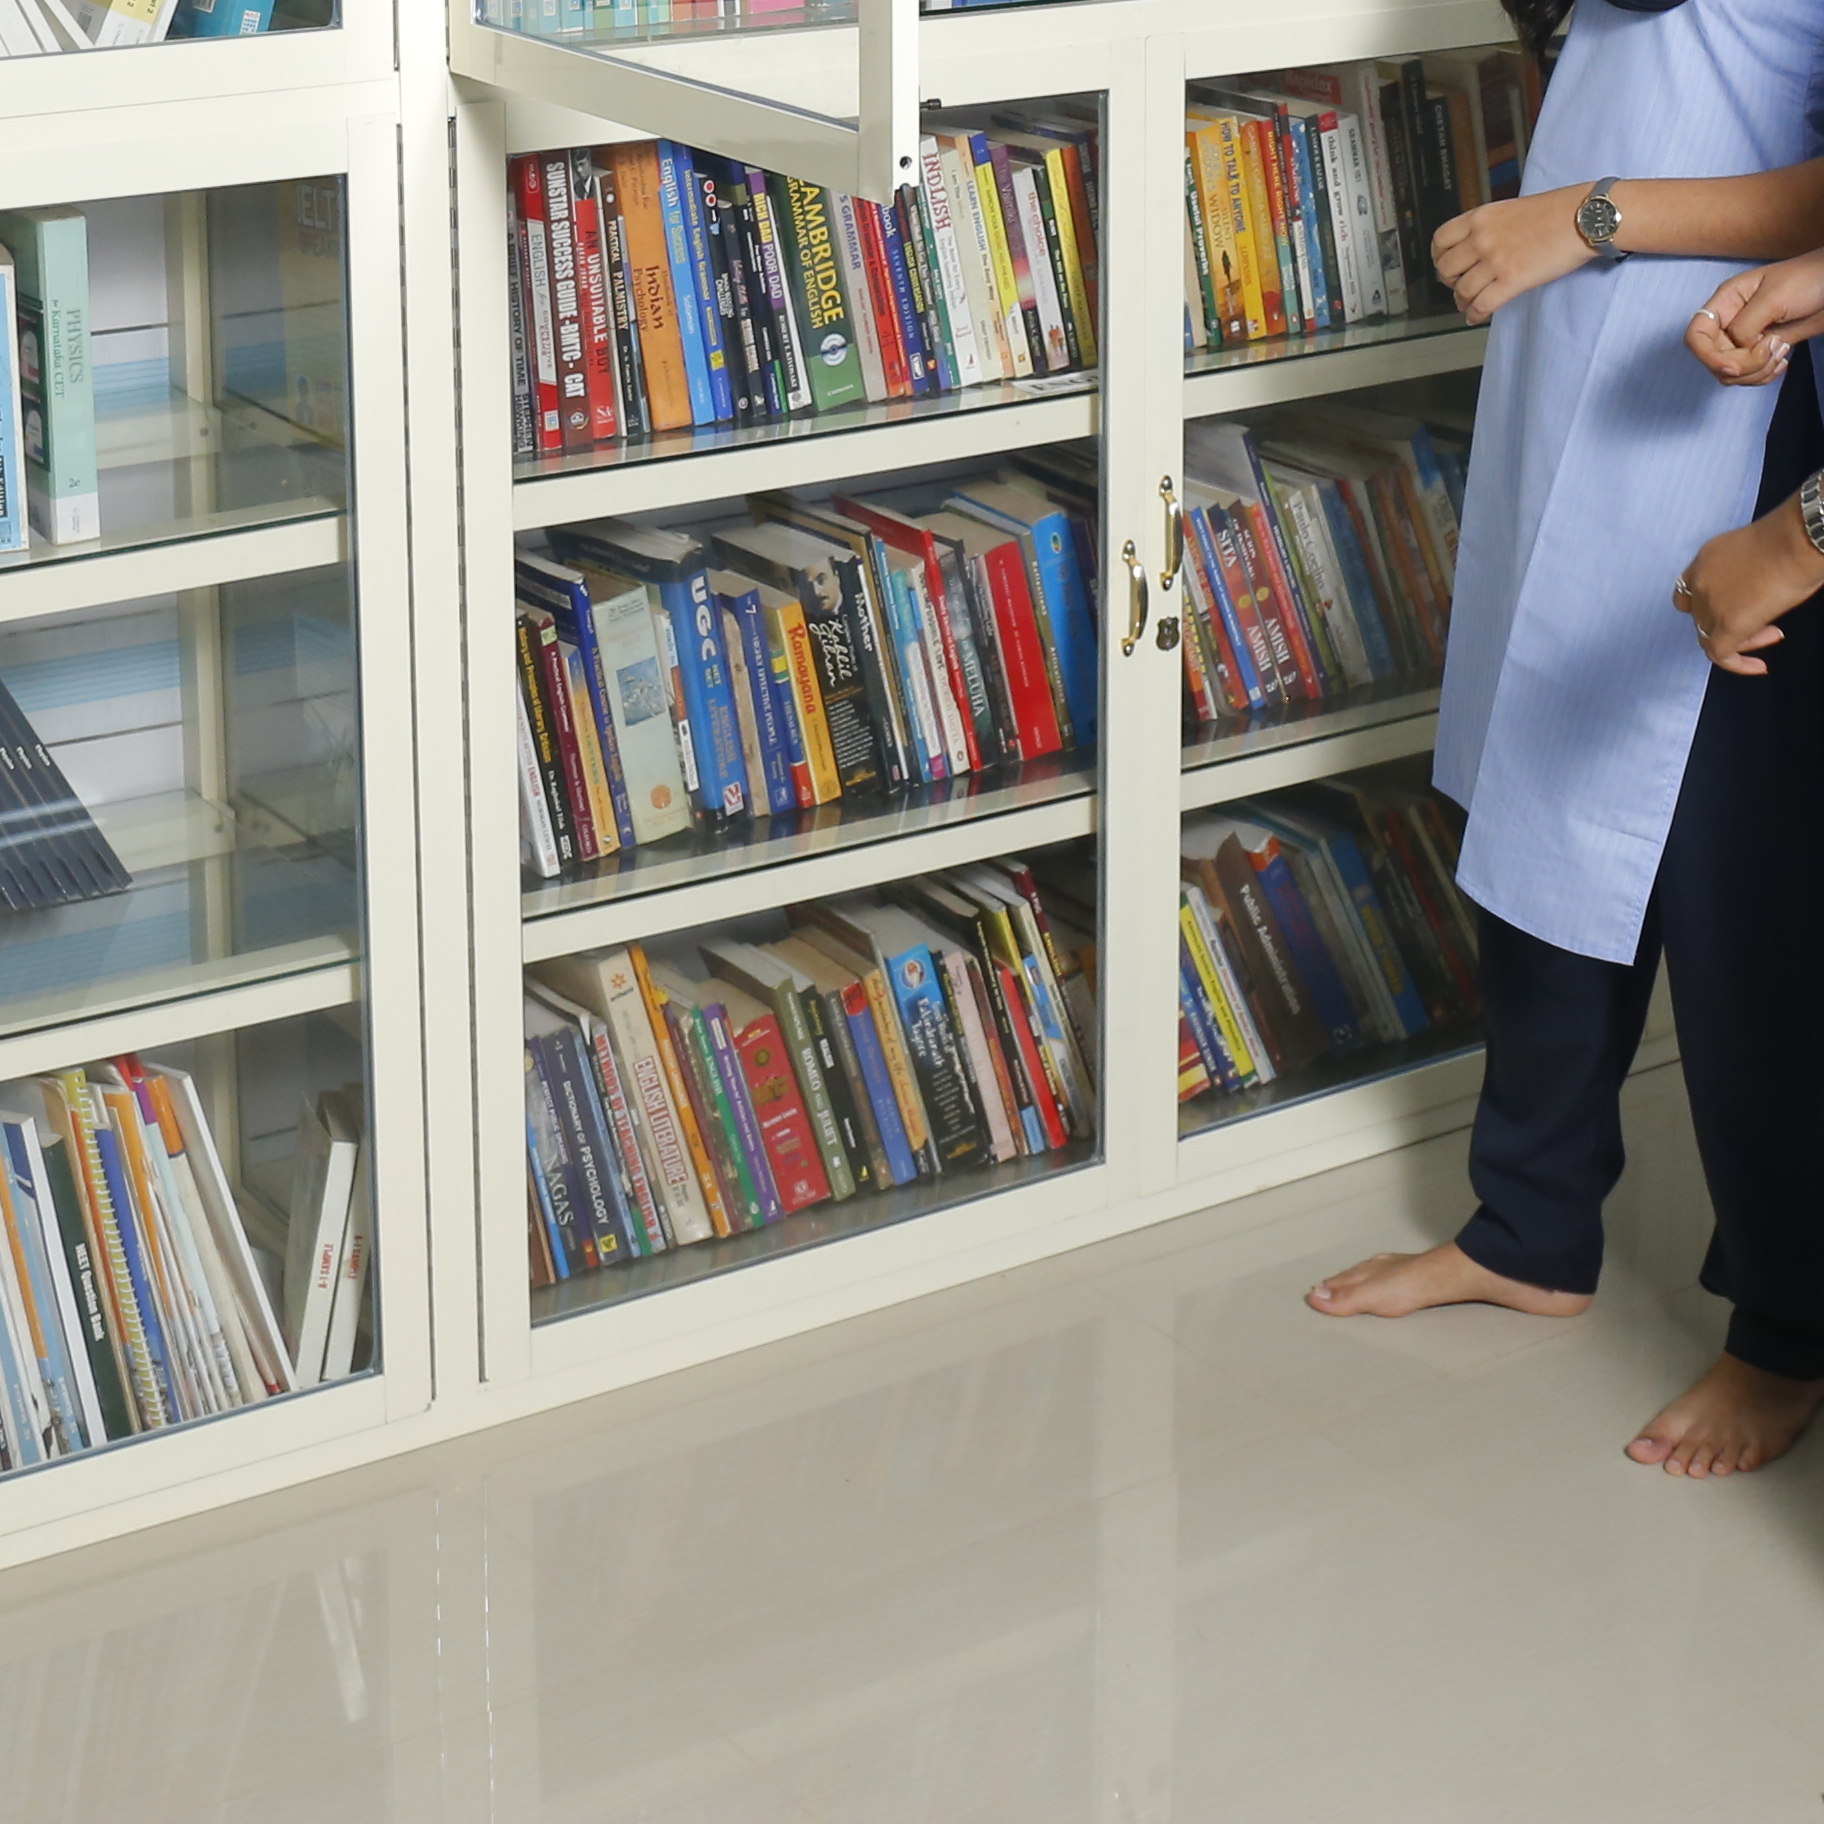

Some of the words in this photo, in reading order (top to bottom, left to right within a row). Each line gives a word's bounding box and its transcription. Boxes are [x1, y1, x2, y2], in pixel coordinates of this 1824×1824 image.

[1220, 121, 1231, 143] HOW
[1226, 157, 1238, 181] TALK
[1328, 135, 1339, 165] think
[1331, 168, 1341, 187] and
[546, 161, 566, 222] SUNSTAR
[662, 157, 679, 211] English
[922, 153, 952, 232] INDLISH
[1333, 191, 1344, 217] grow
[551, 220, 576, 276] SUCCESS
[1338, 220, 1347, 242] rich
[644, 265, 664, 330] Indian
[691, 576, 717, 661] UGC
[1265, 617, 1291, 664] AMISH
[788, 623, 816, 714] Ramayana
[634, 1057, 663, 1114] ENGLISH
[579, 1146, 610, 1225] PSYCHOLOGY
